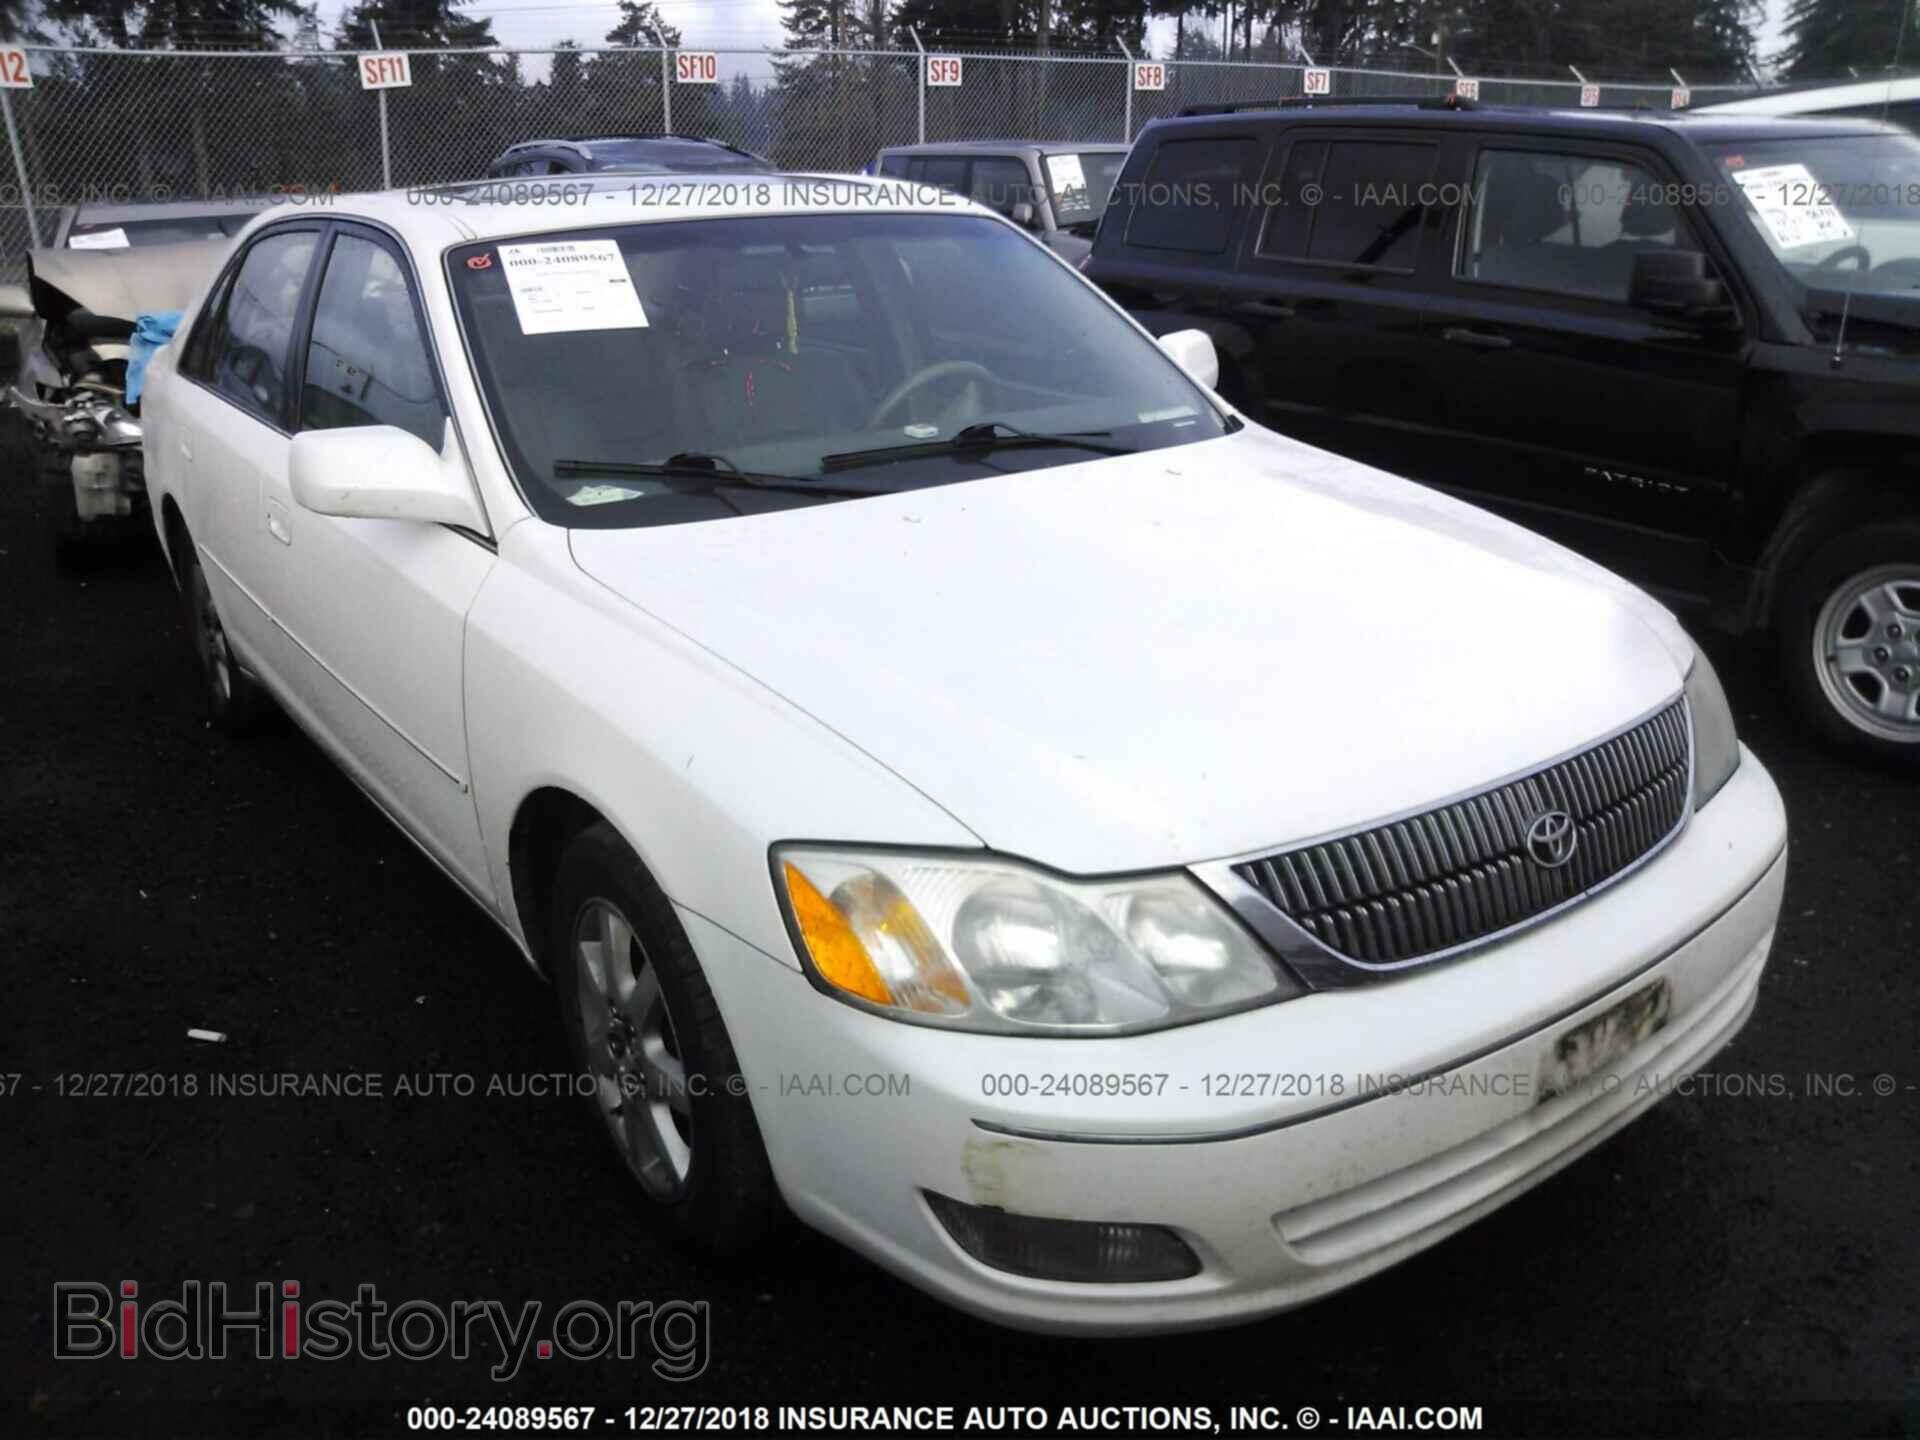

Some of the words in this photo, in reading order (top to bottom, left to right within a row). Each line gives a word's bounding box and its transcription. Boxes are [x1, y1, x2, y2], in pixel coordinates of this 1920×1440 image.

[364, 57, 405, 84] SF11
[677, 55, 716, 79] SF10
[930, 60, 960, 82] SF9
[1137, 66, 1162, 87] SF8
[1307, 72, 1327, 91] SF7
